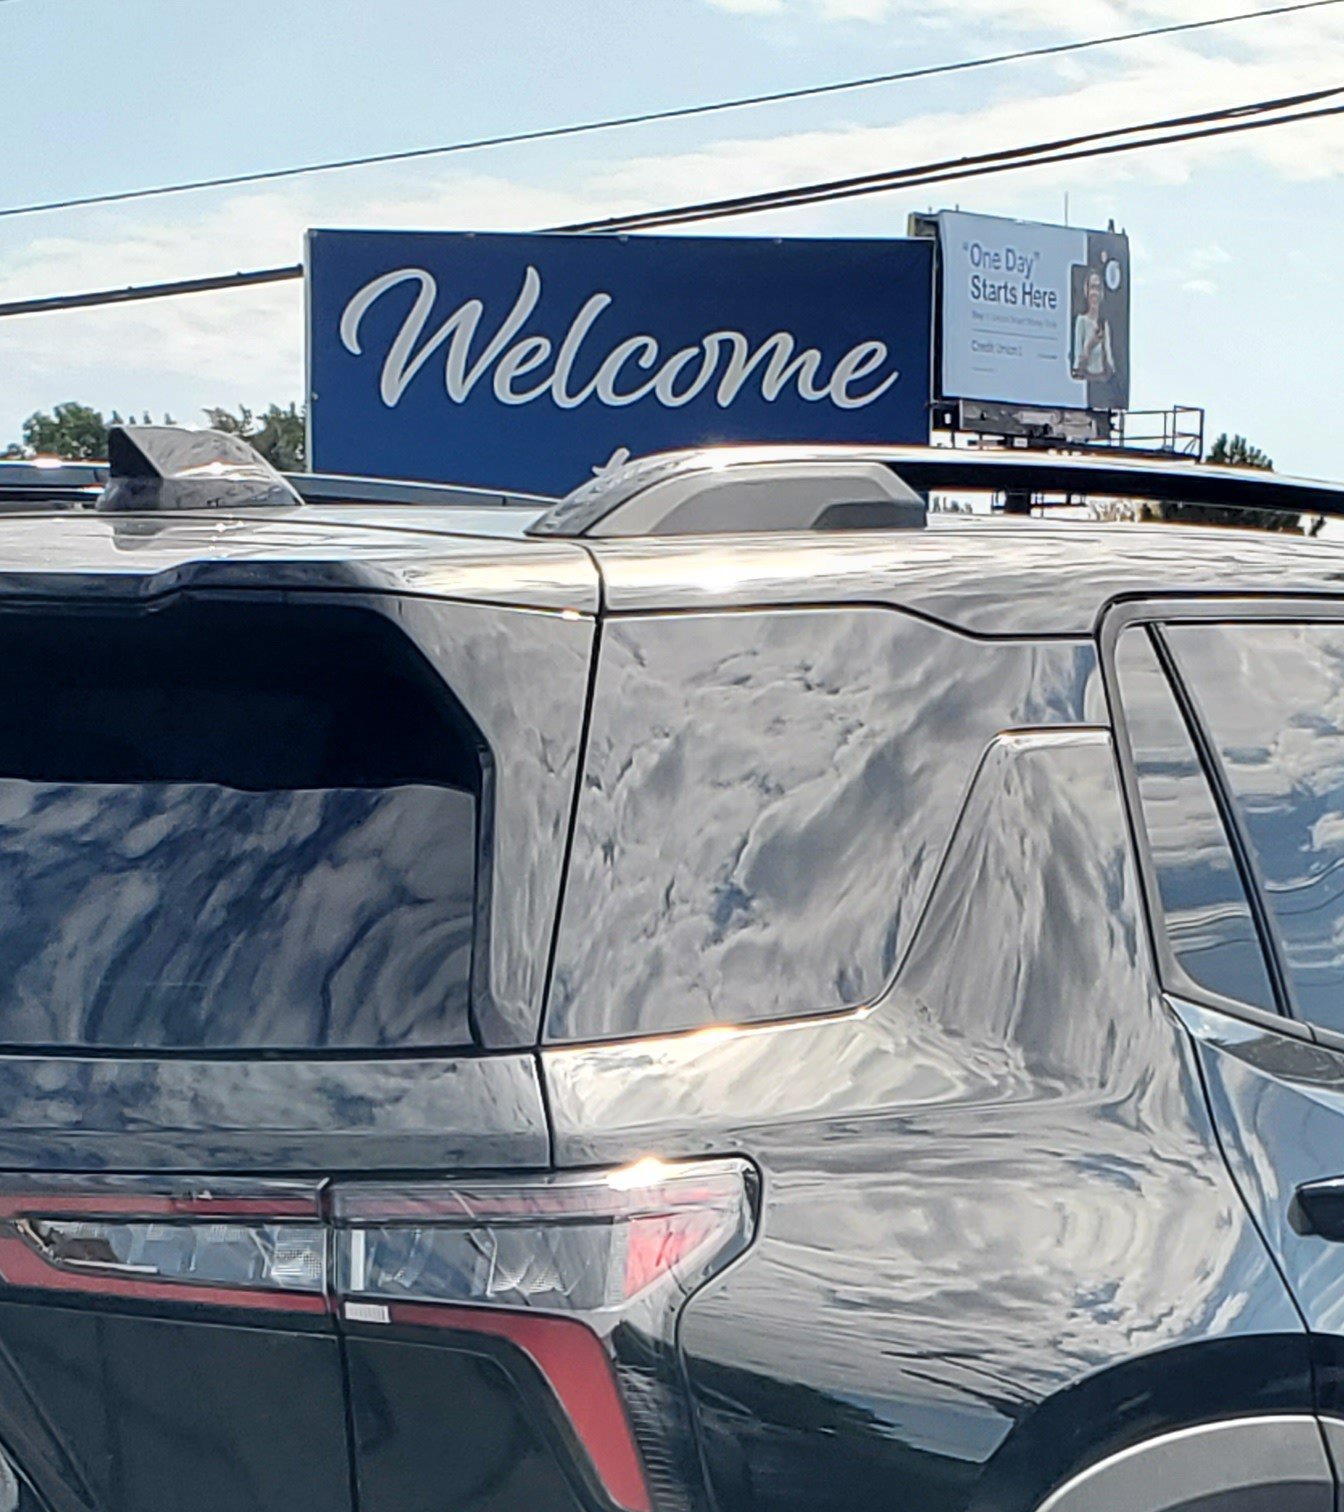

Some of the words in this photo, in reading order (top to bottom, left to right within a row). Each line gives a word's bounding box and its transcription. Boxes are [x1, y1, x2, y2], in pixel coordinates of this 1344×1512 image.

[971, 276, 1017, 304] Starts
[1022, 284, 1057, 310] Here
[339, 266, 899, 409] Welcome
